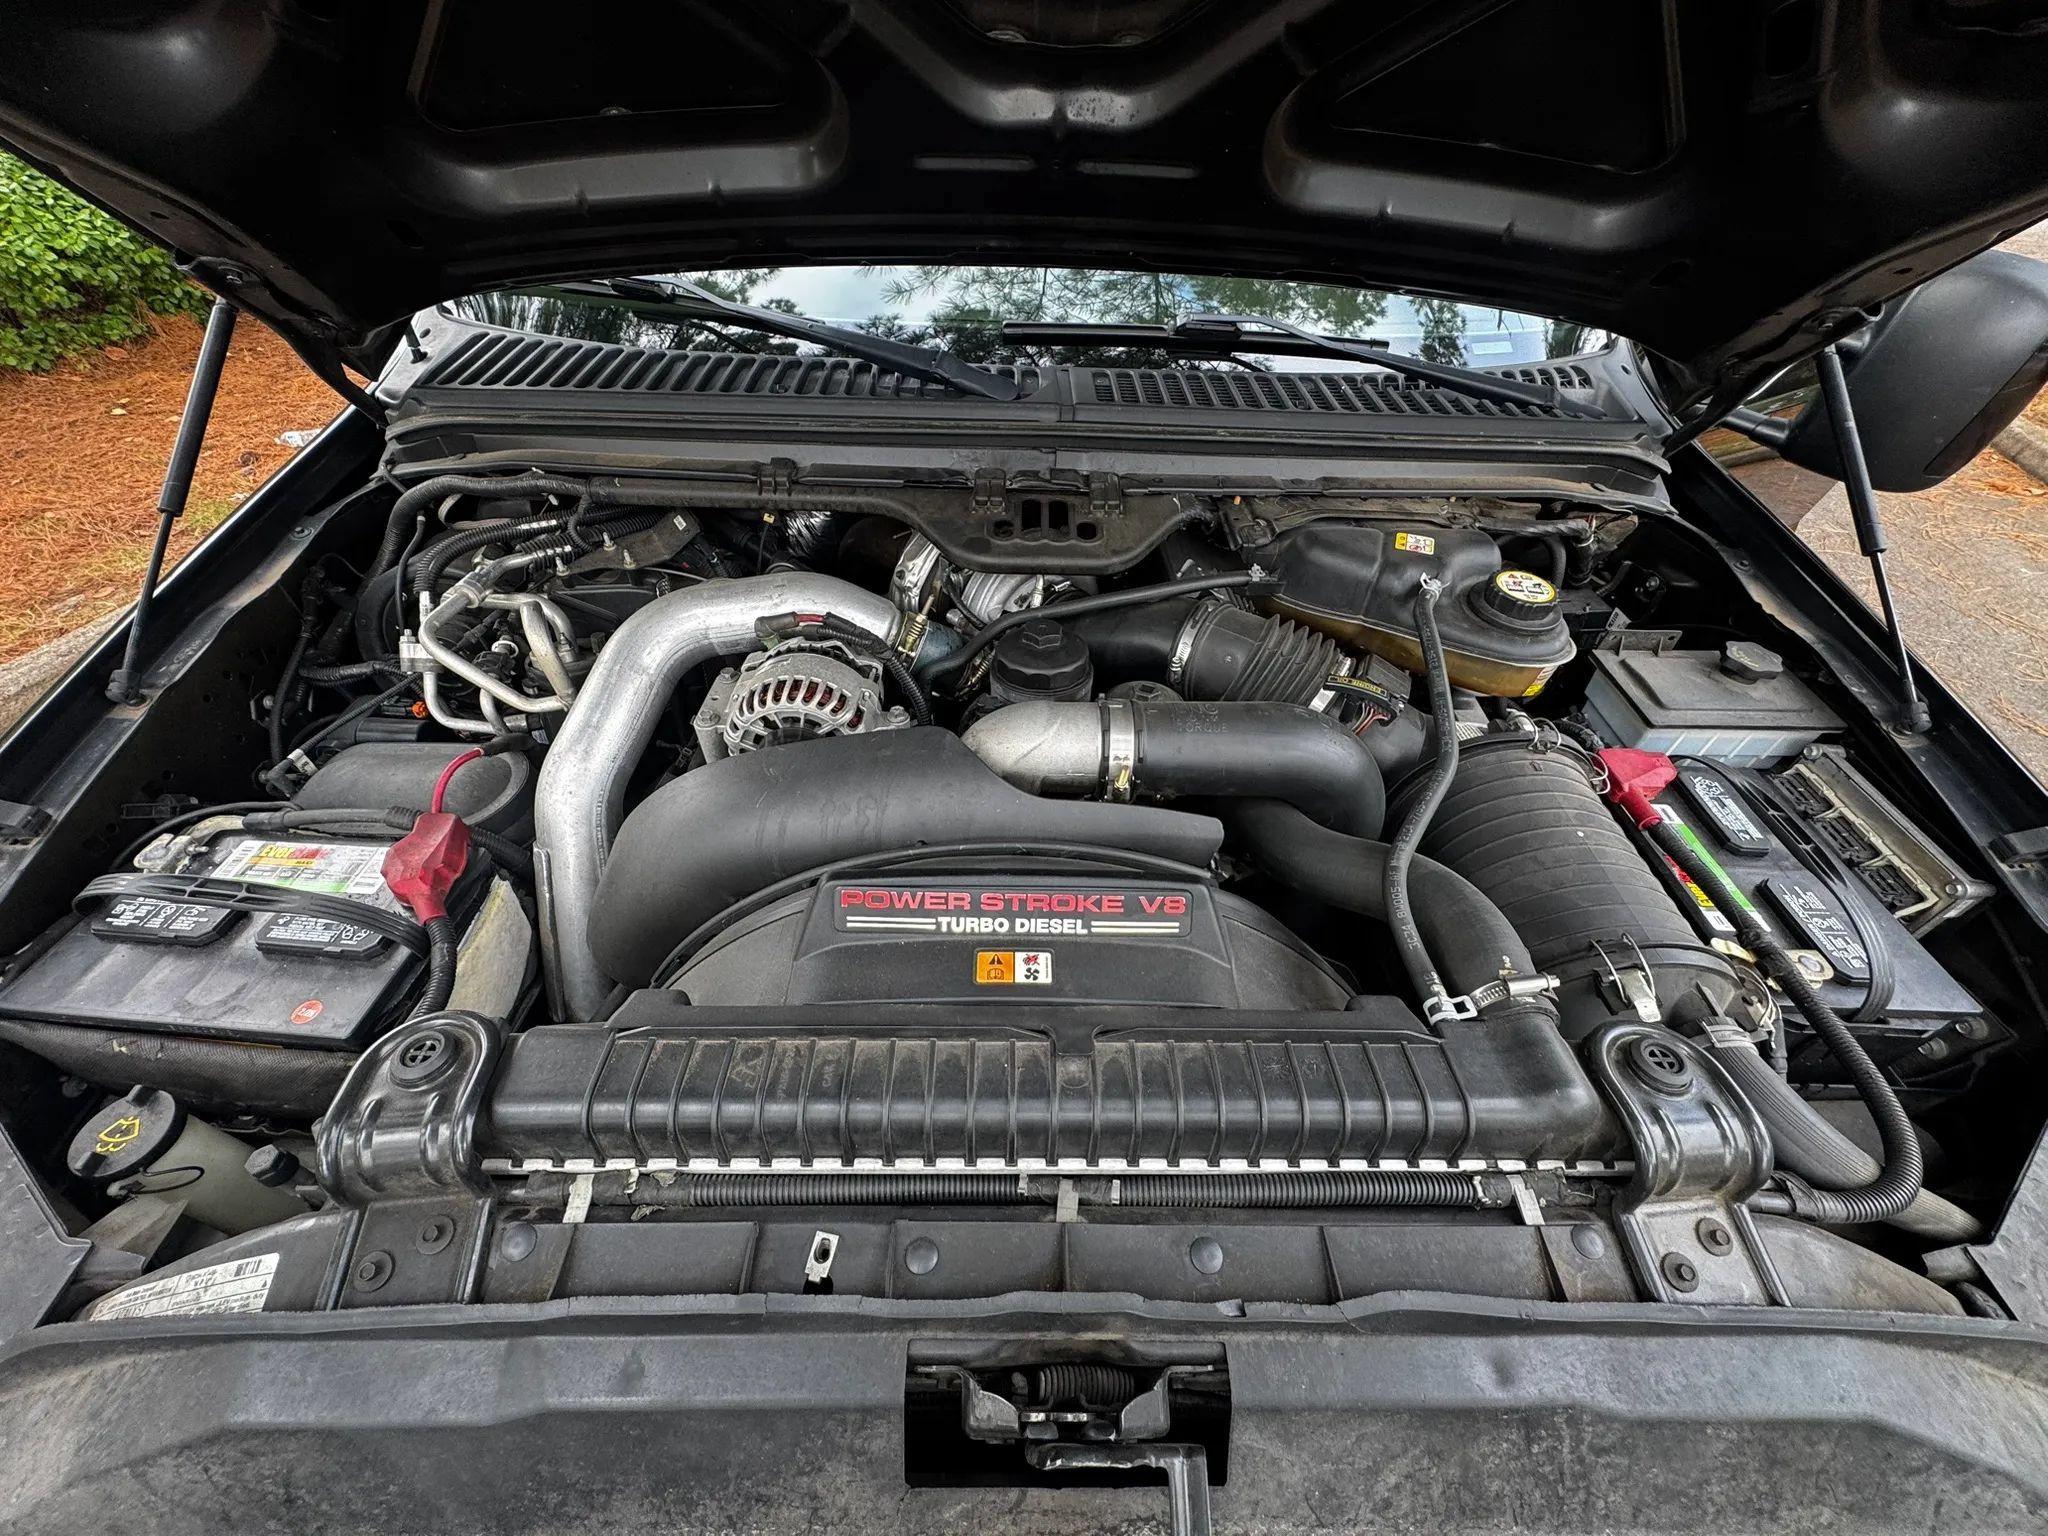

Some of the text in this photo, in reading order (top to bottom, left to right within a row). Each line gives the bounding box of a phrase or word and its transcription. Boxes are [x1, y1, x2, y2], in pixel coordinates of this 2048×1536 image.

[841, 889, 1186, 914] POWER STROKE V8
[937, 917, 1088, 934] TURBO DIESEL
